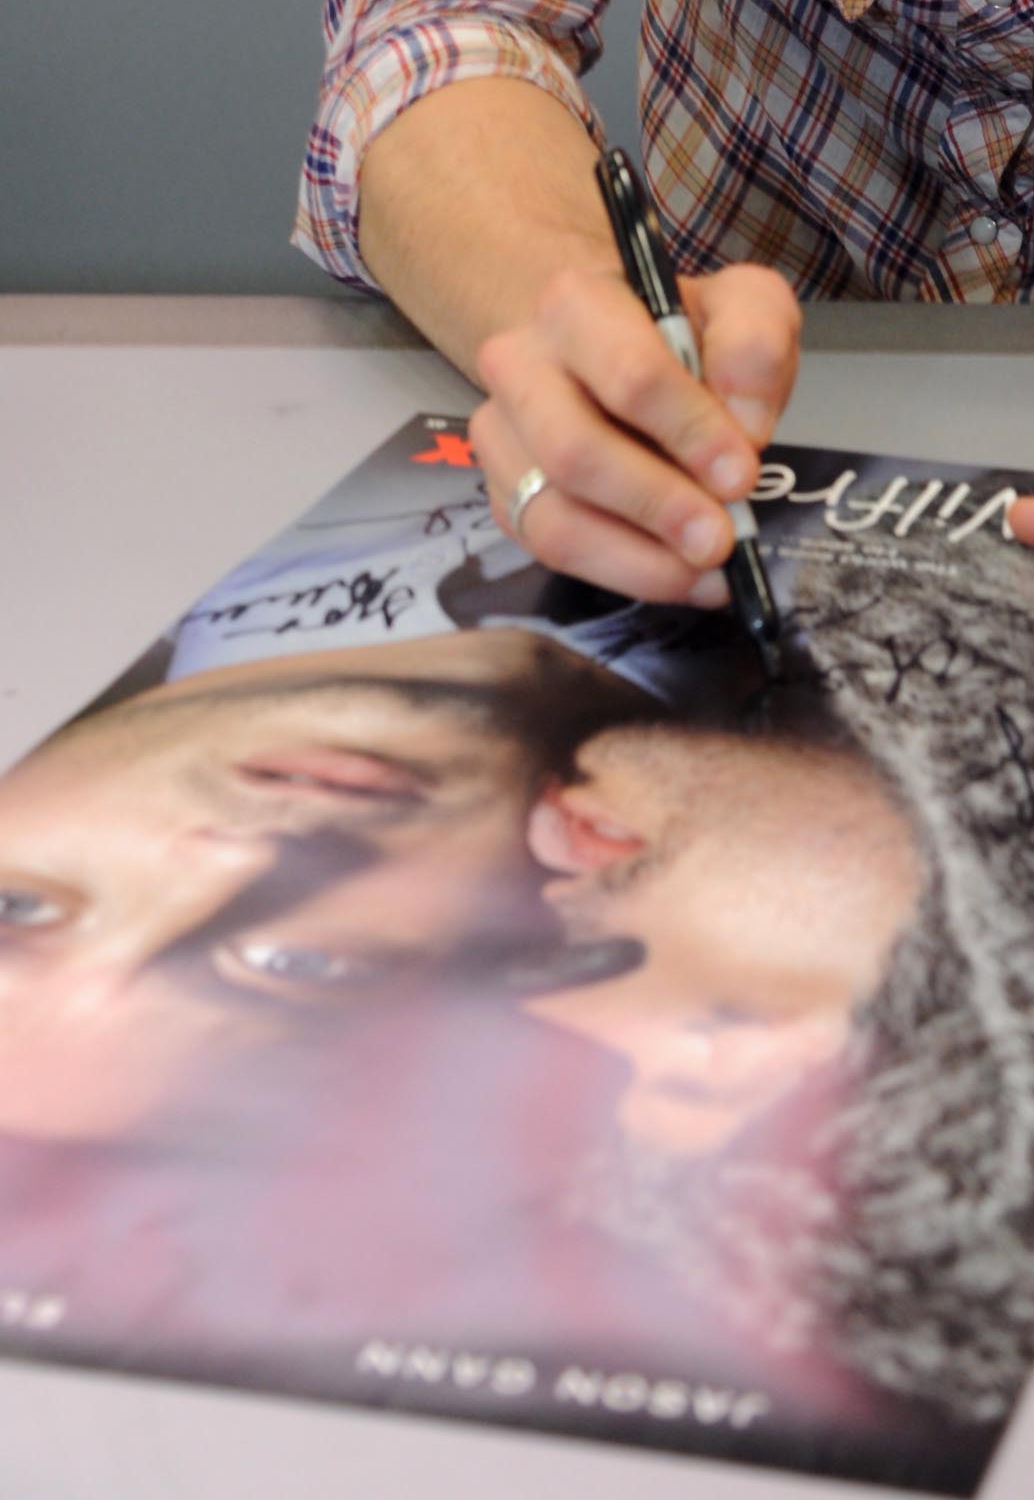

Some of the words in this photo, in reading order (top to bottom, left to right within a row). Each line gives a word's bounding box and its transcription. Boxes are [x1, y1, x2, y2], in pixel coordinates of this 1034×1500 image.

[752, 462, 1017, 541] Wilfre
[356, 1337, 538, 1397] GANN
[556, 1362, 769, 1430] JASON
